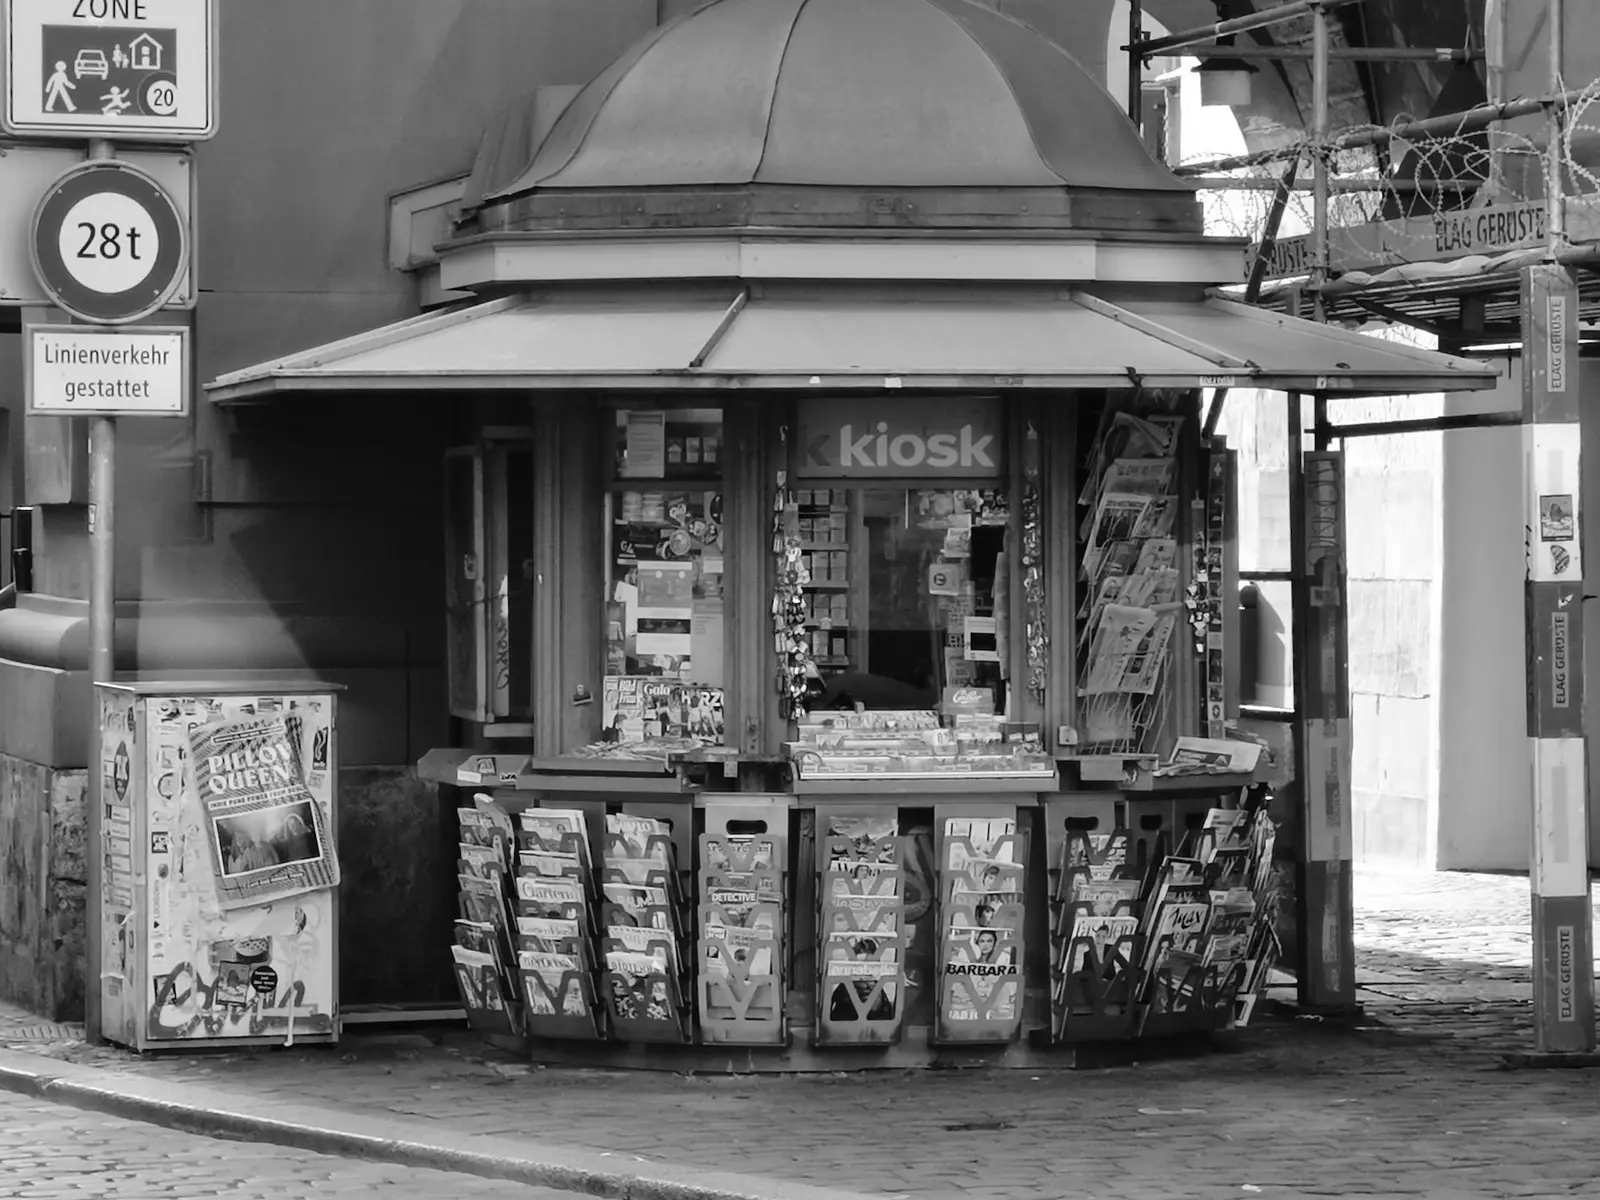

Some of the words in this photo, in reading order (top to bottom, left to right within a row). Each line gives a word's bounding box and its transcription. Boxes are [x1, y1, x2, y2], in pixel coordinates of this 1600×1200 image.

[73, 0, 147, 19] ZONE
[153, 88, 174, 107] 20
[45, 343, 170, 366] Linienverkehr
[1551, 358, 1562, 388] ELAG
[65, 379, 150, 402] gestattet
[840, 421, 995, 467] kiosk
[643, 683, 671, 696] Gala
[1555, 672, 1565, 705] ELAG
[711, 891, 756, 903] DETECTIVE
[946, 964, 1017, 976] BARBARA
[1561, 987, 1572, 1018] ELAG
